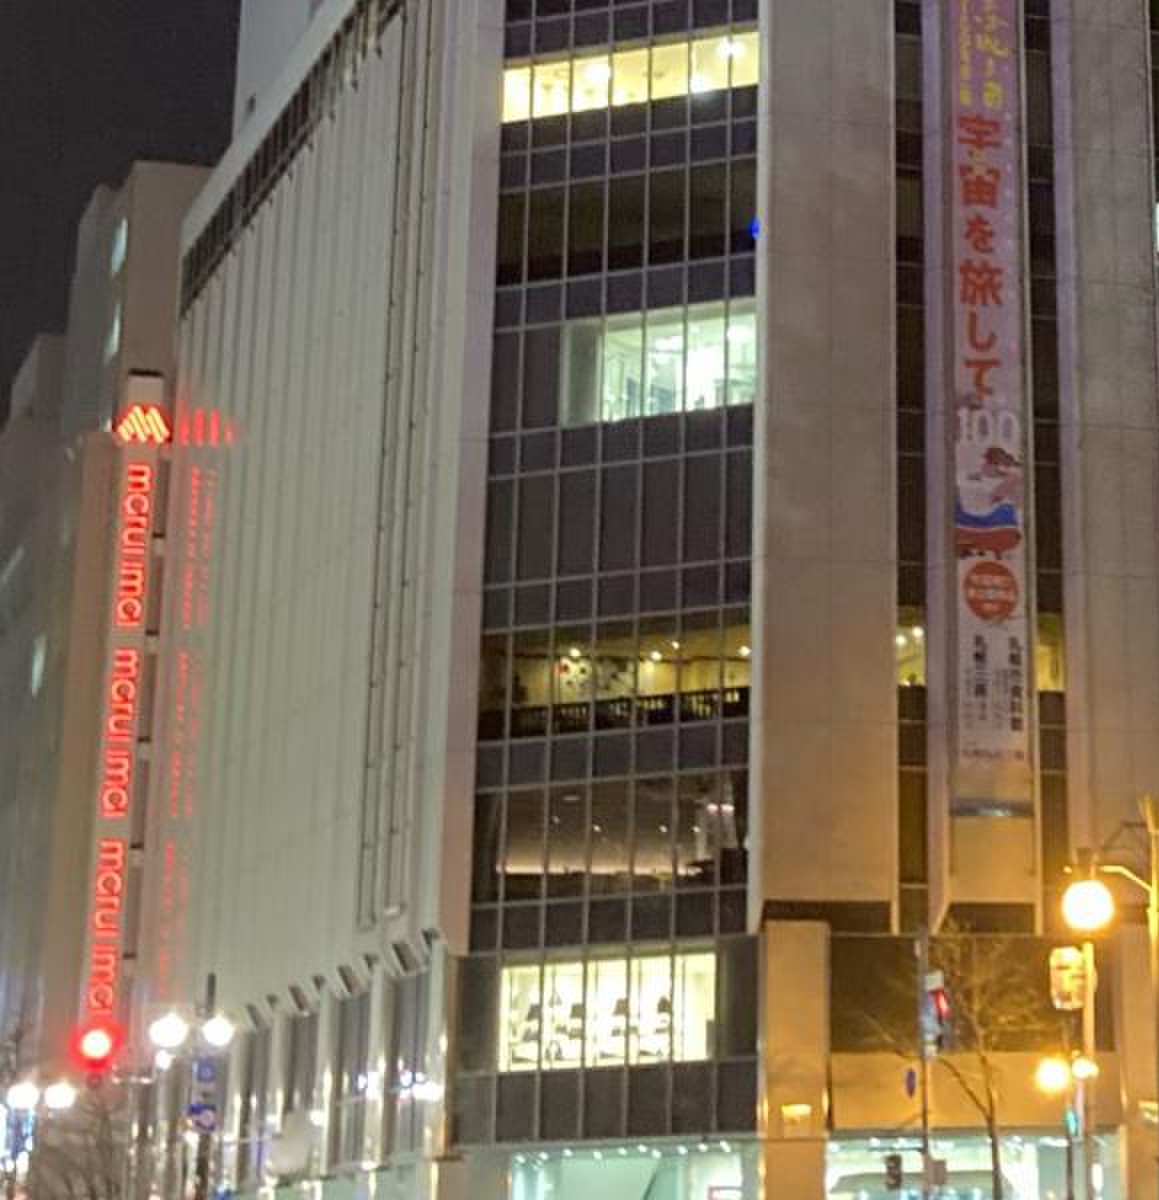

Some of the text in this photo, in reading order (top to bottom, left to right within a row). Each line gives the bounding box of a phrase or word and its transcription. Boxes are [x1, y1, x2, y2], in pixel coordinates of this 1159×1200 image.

[957, 115, 1003, 400] 宇宙を旅して
[116, 465, 151, 627] marui imai
[101, 649, 138, 817] marui imai
[94, 837, 124, 938] marui
